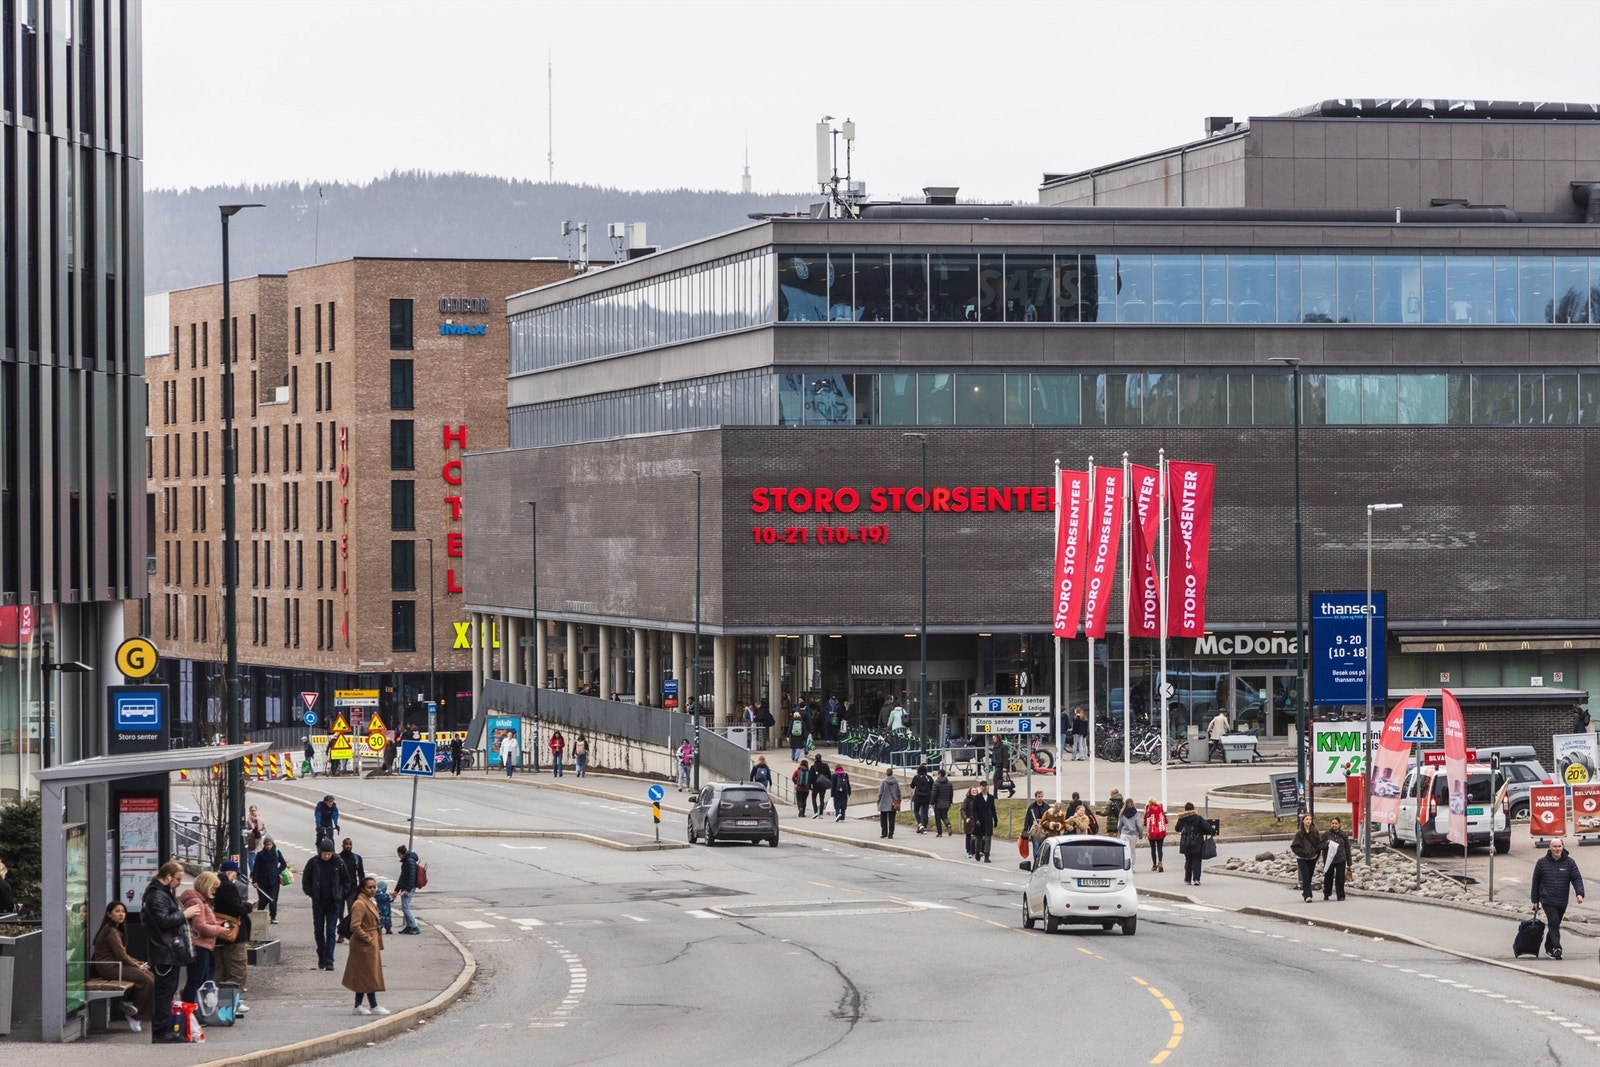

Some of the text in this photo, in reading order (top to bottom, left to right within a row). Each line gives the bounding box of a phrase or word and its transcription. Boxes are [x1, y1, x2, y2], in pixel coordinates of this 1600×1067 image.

[439, 297, 489, 314] ODEON
[440, 323, 486, 336] IMAX
[443, 424, 466, 593] HOTEL
[751, 487, 860, 513] STORO
[339, 426, 348, 595] HOTEL
[752, 523, 889, 545] 10-21 (10-19)
[1055, 479, 1081, 630] STORO STORSENTER
[1086, 476, 1116, 629] STORO STORSENTER
[1183, 574, 1197, 629] STORO
[1320, 602, 1377, 615] thansen
[1336, 635, 1342, 645] 9
[1349, 635, 1362, 645] 20
[126, 647, 144, 669] G
[851, 665, 903, 675] INNGANG
[118, 733, 158, 741] Storo senter
[370, 736, 383, 747] 30
[1317, 732, 1360, 752] KIWI
[1362, 741, 1379, 752] pis
[1567, 769, 1586, 780] 20%
